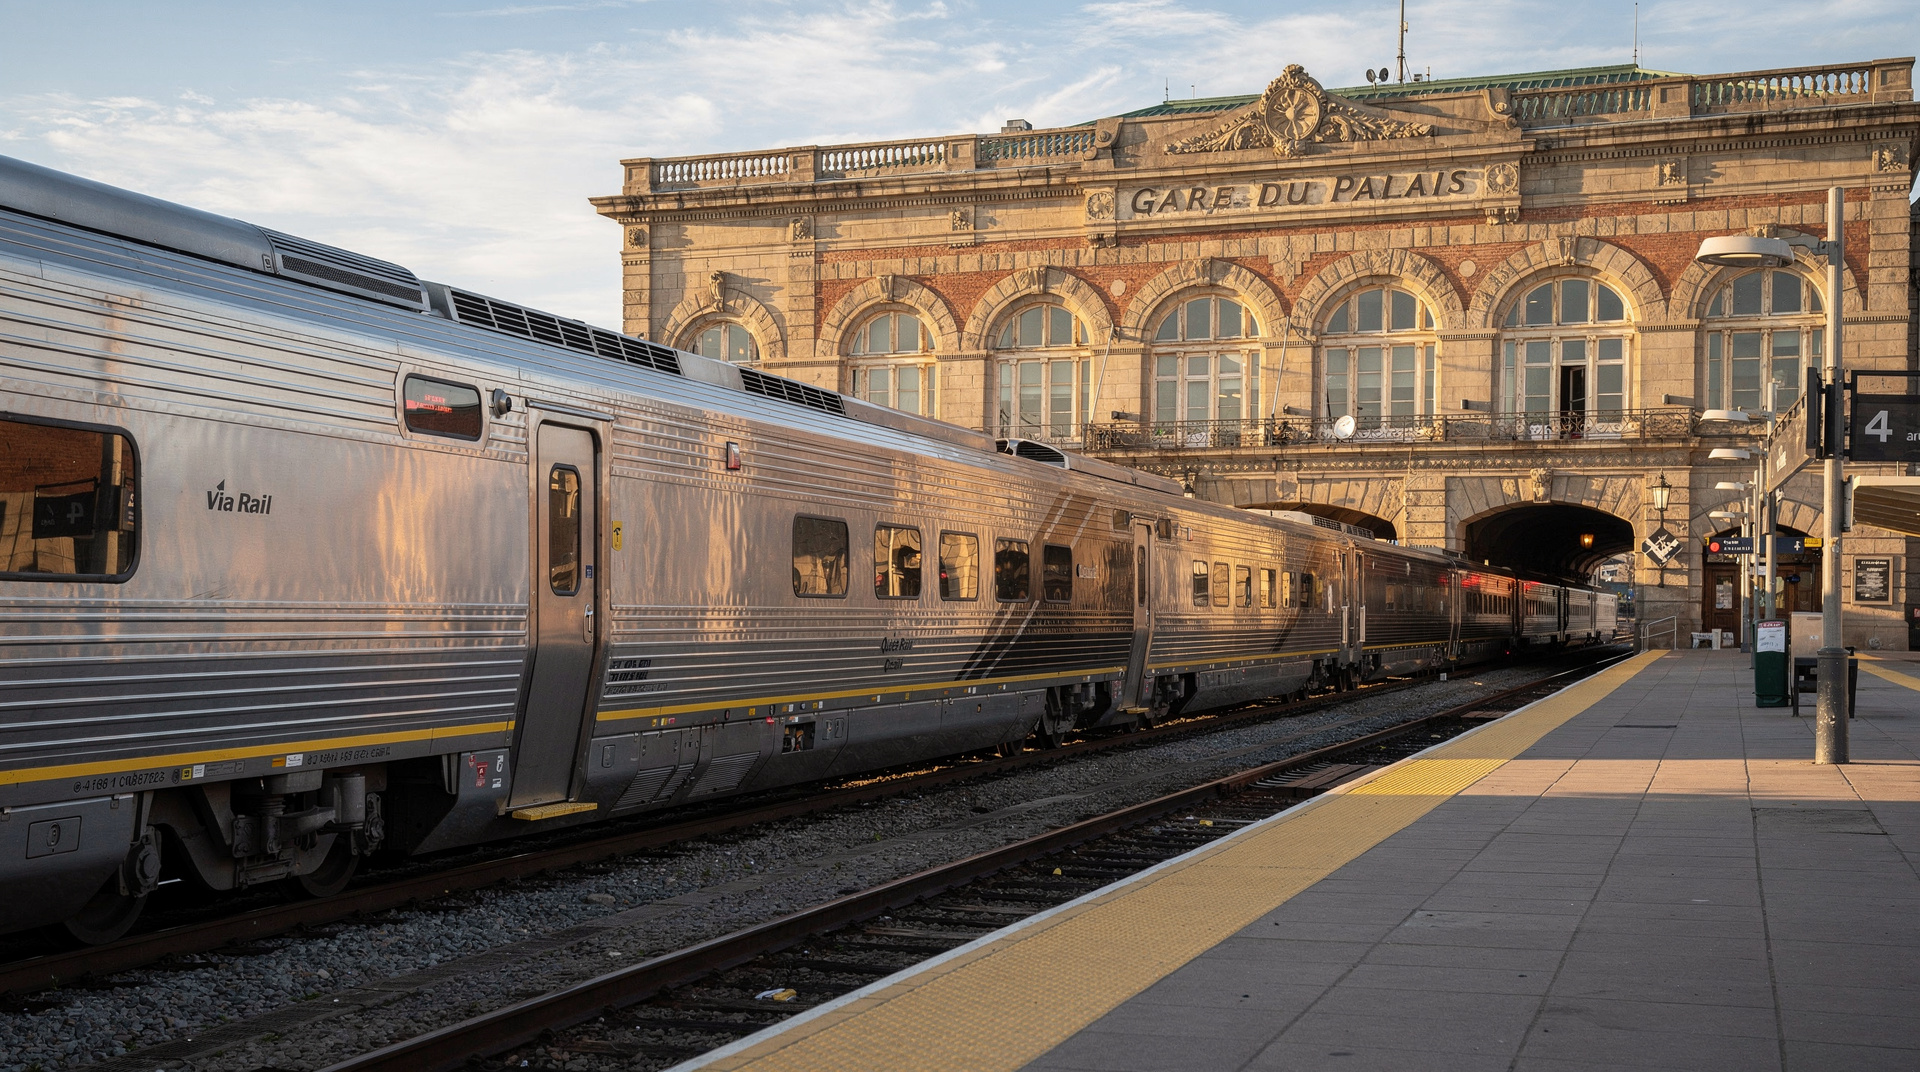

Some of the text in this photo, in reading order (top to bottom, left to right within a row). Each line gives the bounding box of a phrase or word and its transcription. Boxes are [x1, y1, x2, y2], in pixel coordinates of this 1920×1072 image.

[1131, 170, 1467, 216] GARE DU PALAIS
[1864, 410, 1893, 443] 4
[1906, 432, 1920, 442] ar
[207, 490, 272, 515] Via Rail
